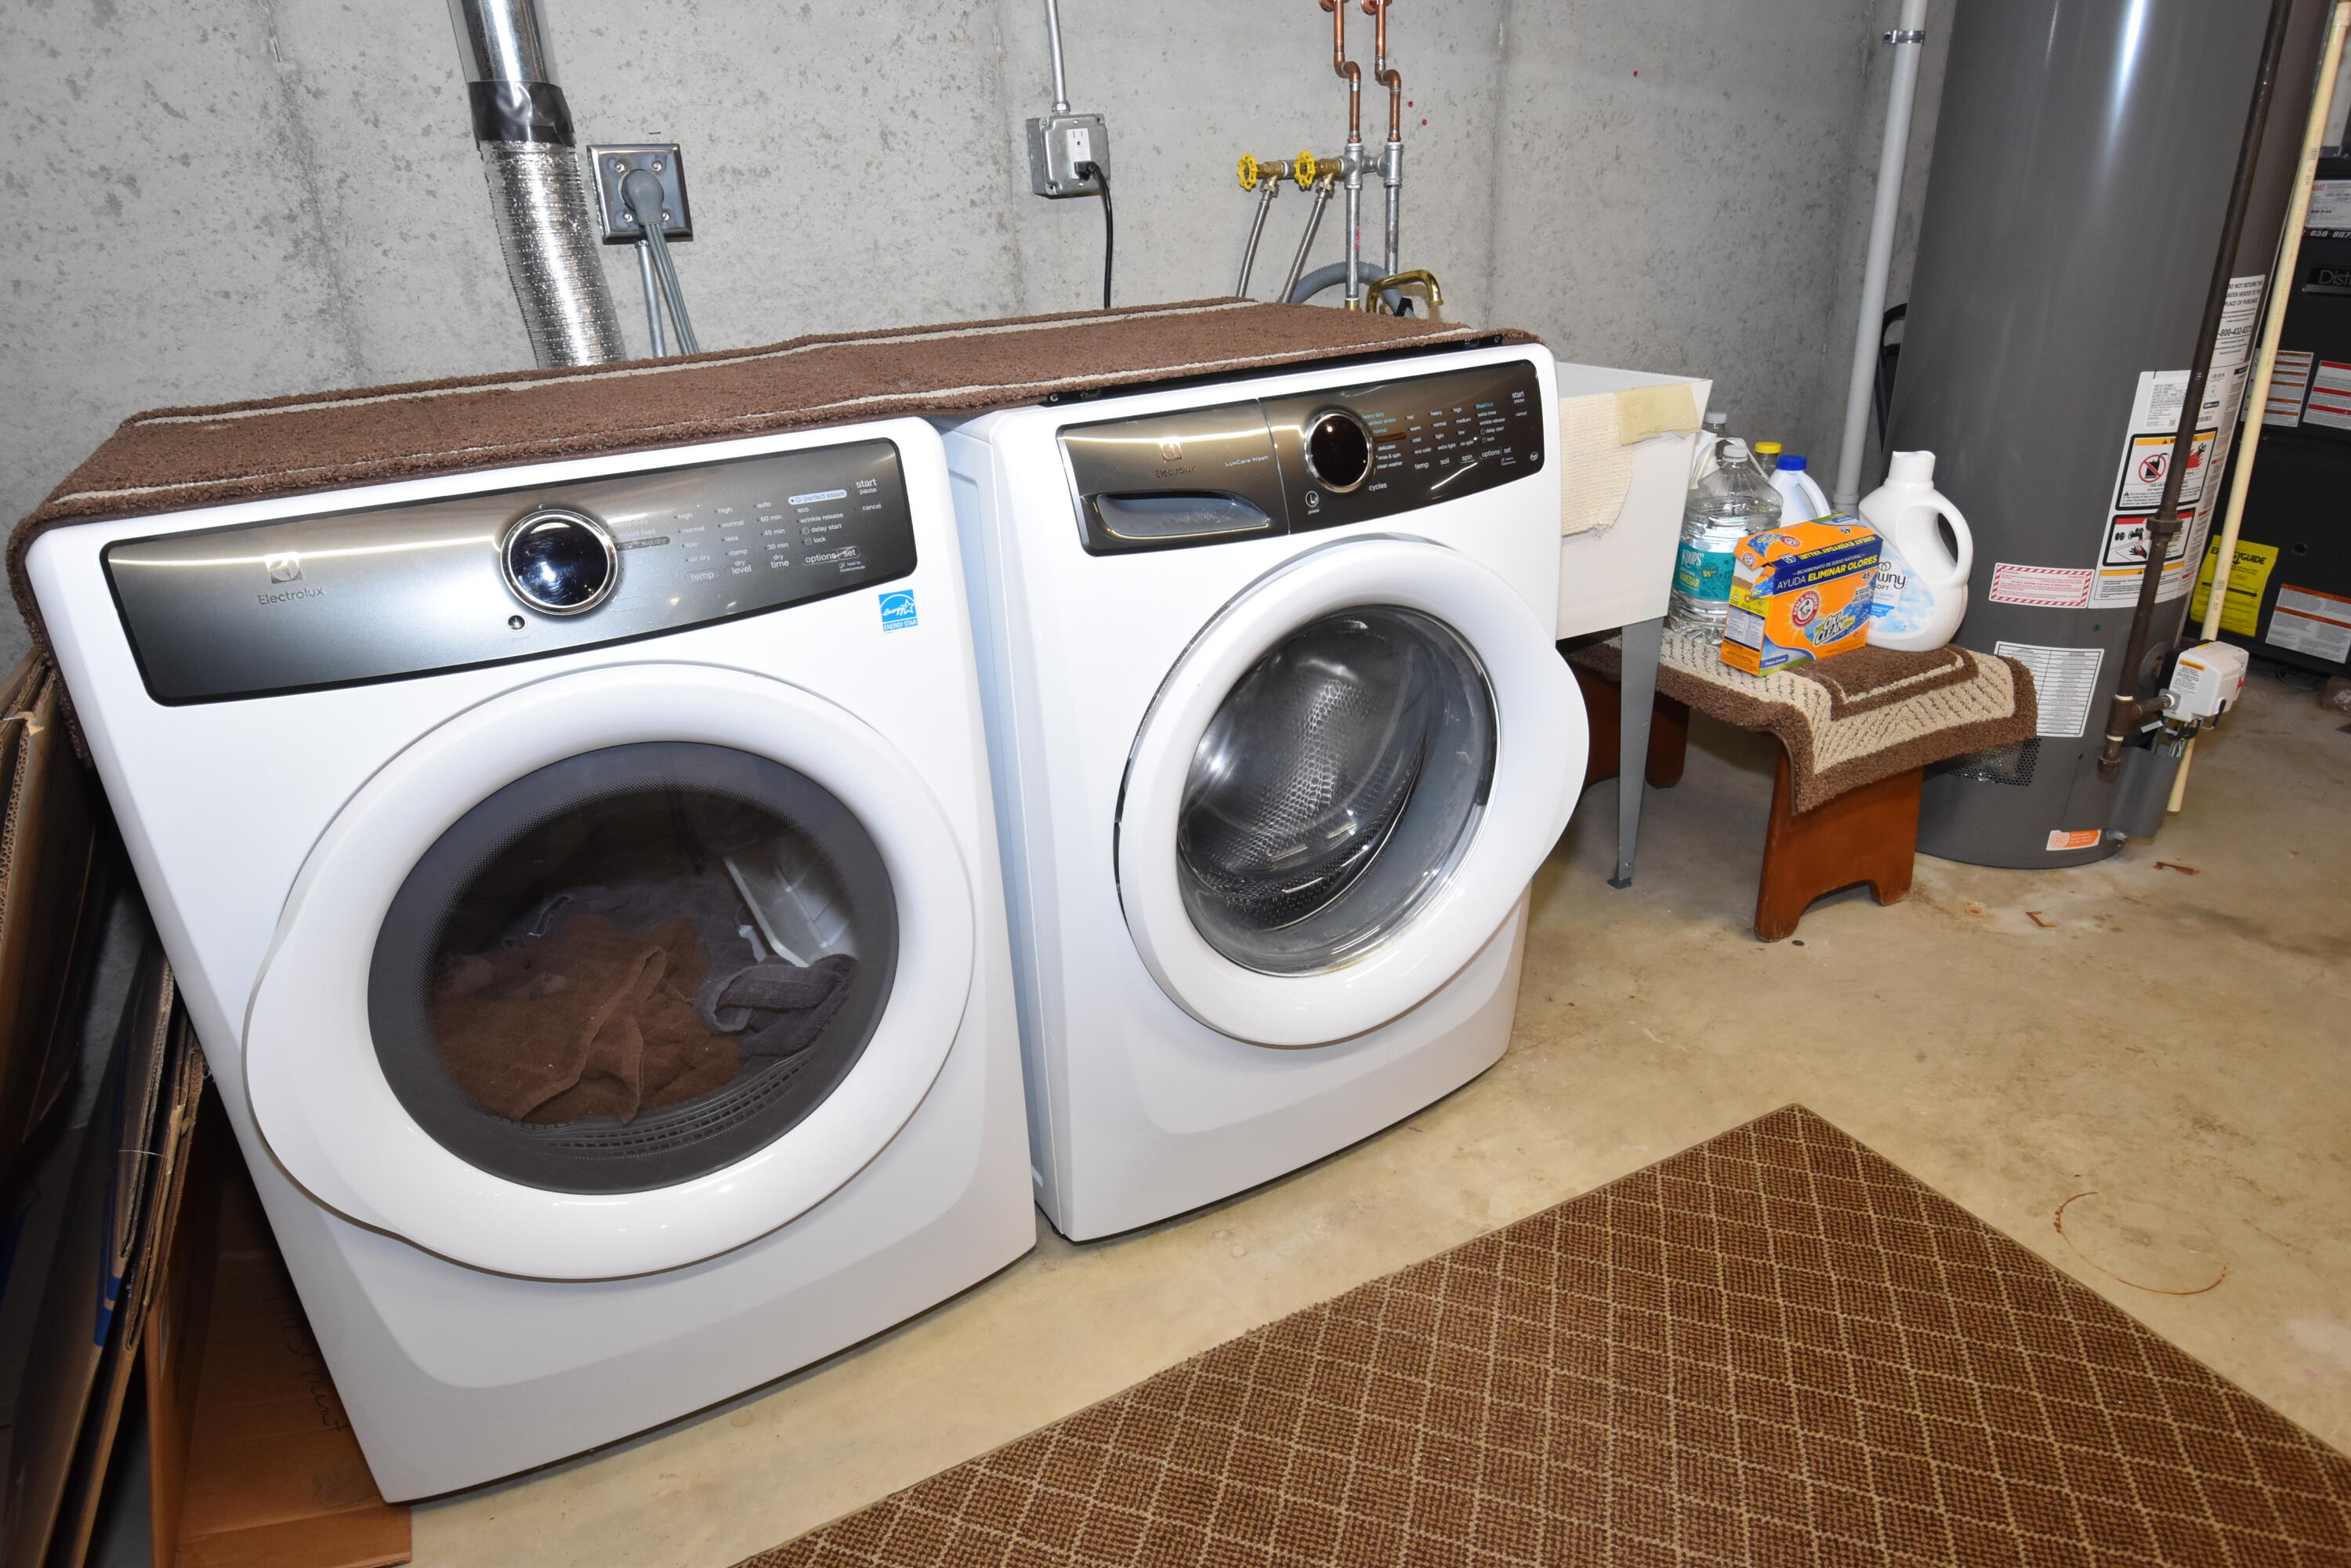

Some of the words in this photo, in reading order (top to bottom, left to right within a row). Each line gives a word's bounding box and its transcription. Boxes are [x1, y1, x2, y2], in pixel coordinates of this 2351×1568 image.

[1482, 449, 1500, 458] options
[1225, 458, 1251, 467] LuxCare
[1155, 465, 1196, 478] Electrolux
[856, 478, 877, 489] start
[1369, 483, 1387, 492] cycles
[800, 515, 821, 523] wrinkle
[811, 525, 827, 533] delay
[1855, 536, 1875, 545] GREAT
[1823, 541, 1853, 554] EVERYDAY
[805, 552, 836, 564] options
[843, 549, 856, 557] set
[771, 560, 789, 568] time
[1797, 564, 1825, 575] BICARBONATO
[1844, 554, 1862, 562] NATURAL
[732, 565, 752, 574] level
[1777, 576, 1806, 590] AYUDA
[1808, 565, 1846, 582] ELIMINAR
[1847, 555, 1878, 570] OLORES
[690, 571, 714, 582] temp
[1680, 572, 1700, 588] VINEGAR
[1862, 571, 1871, 581] 45
[1877, 572, 1906, 590] wny
[257, 586, 324, 605] Electrolux
[883, 622, 903, 631] ENERGY
